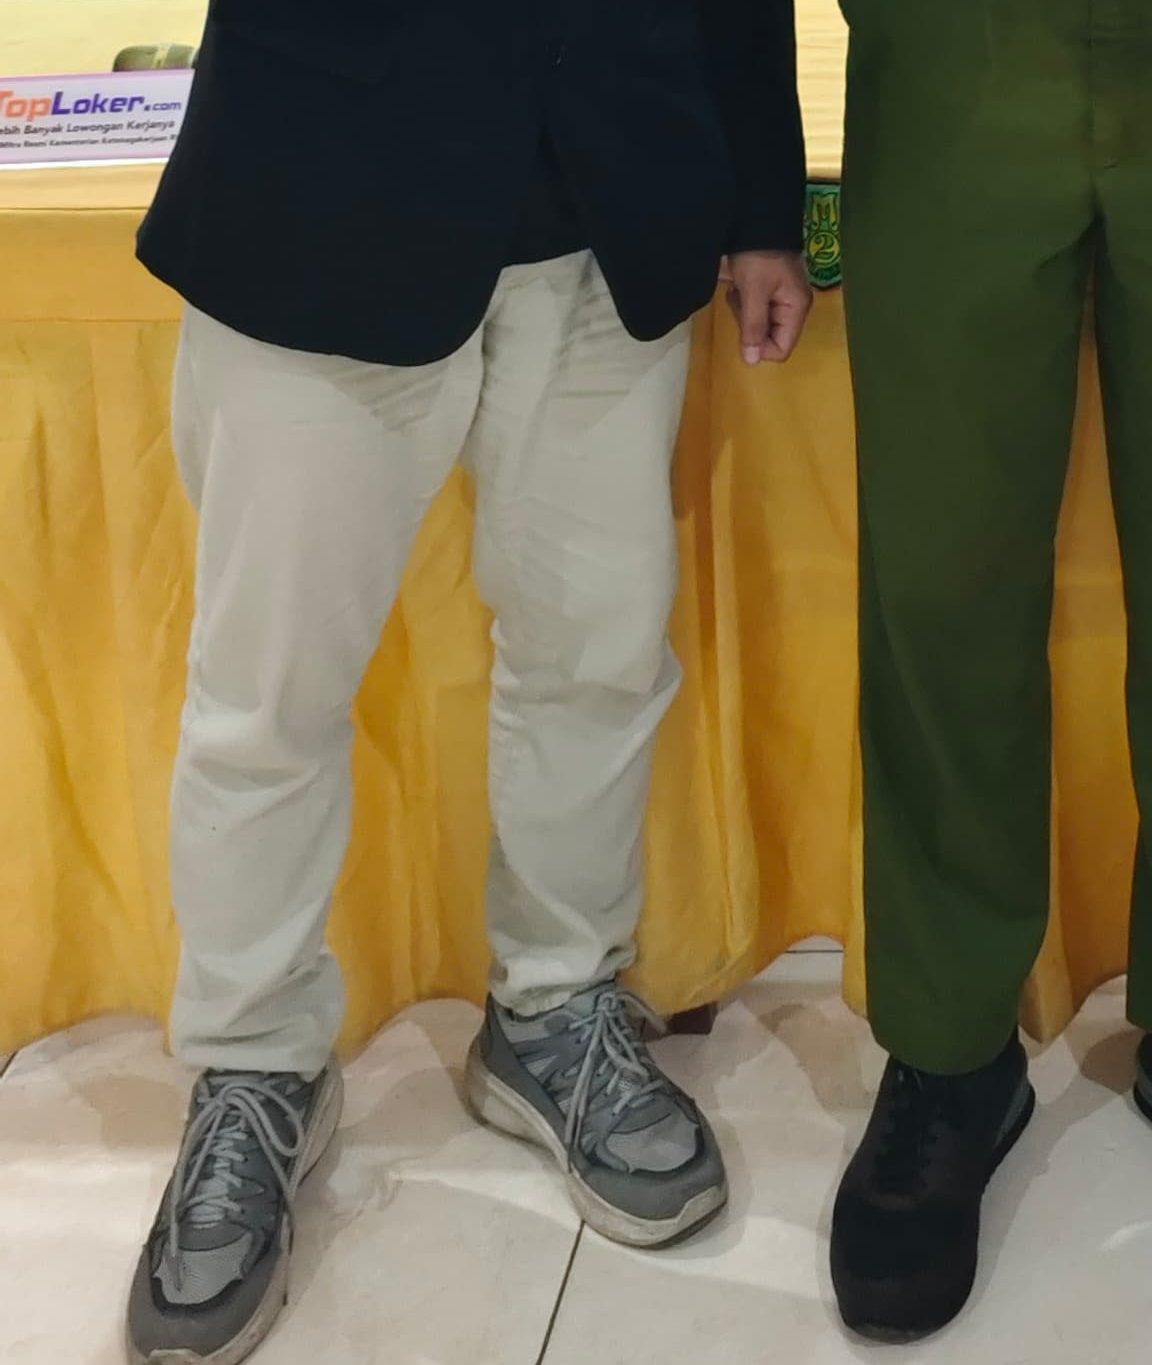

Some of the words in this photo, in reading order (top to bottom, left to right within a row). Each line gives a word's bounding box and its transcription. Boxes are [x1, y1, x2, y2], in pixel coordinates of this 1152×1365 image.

[24, 122, 63, 137] Banyak
[66, 121, 123, 134] Lowongan
[127, 119, 175, 132] Kerjanya
